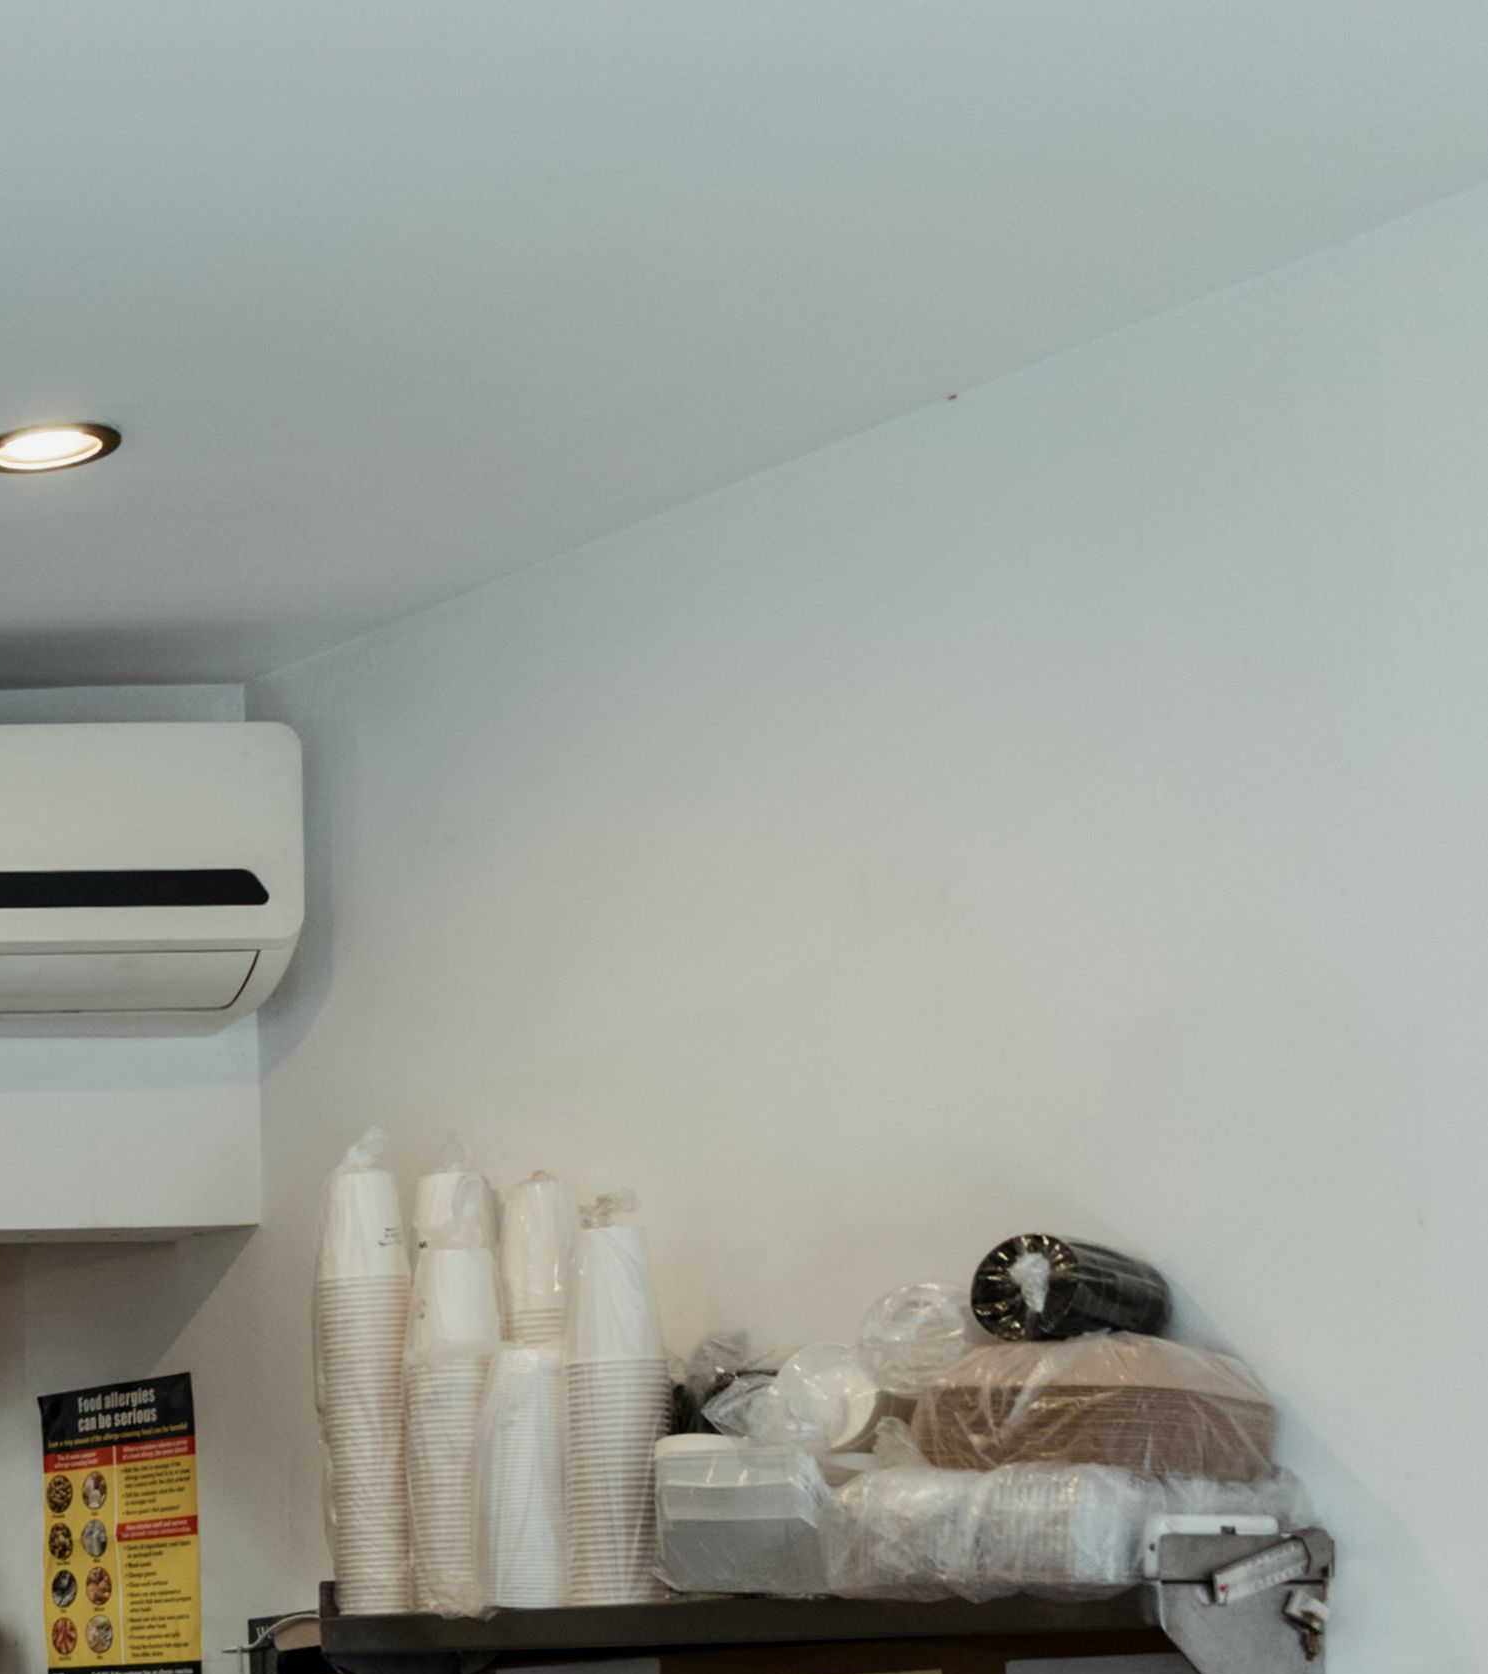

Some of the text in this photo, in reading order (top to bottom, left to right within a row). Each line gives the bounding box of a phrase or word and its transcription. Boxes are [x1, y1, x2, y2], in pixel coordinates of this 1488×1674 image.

[78, 1387, 155, 1414] Food allergies
[78, 1406, 157, 1433] can be serious
